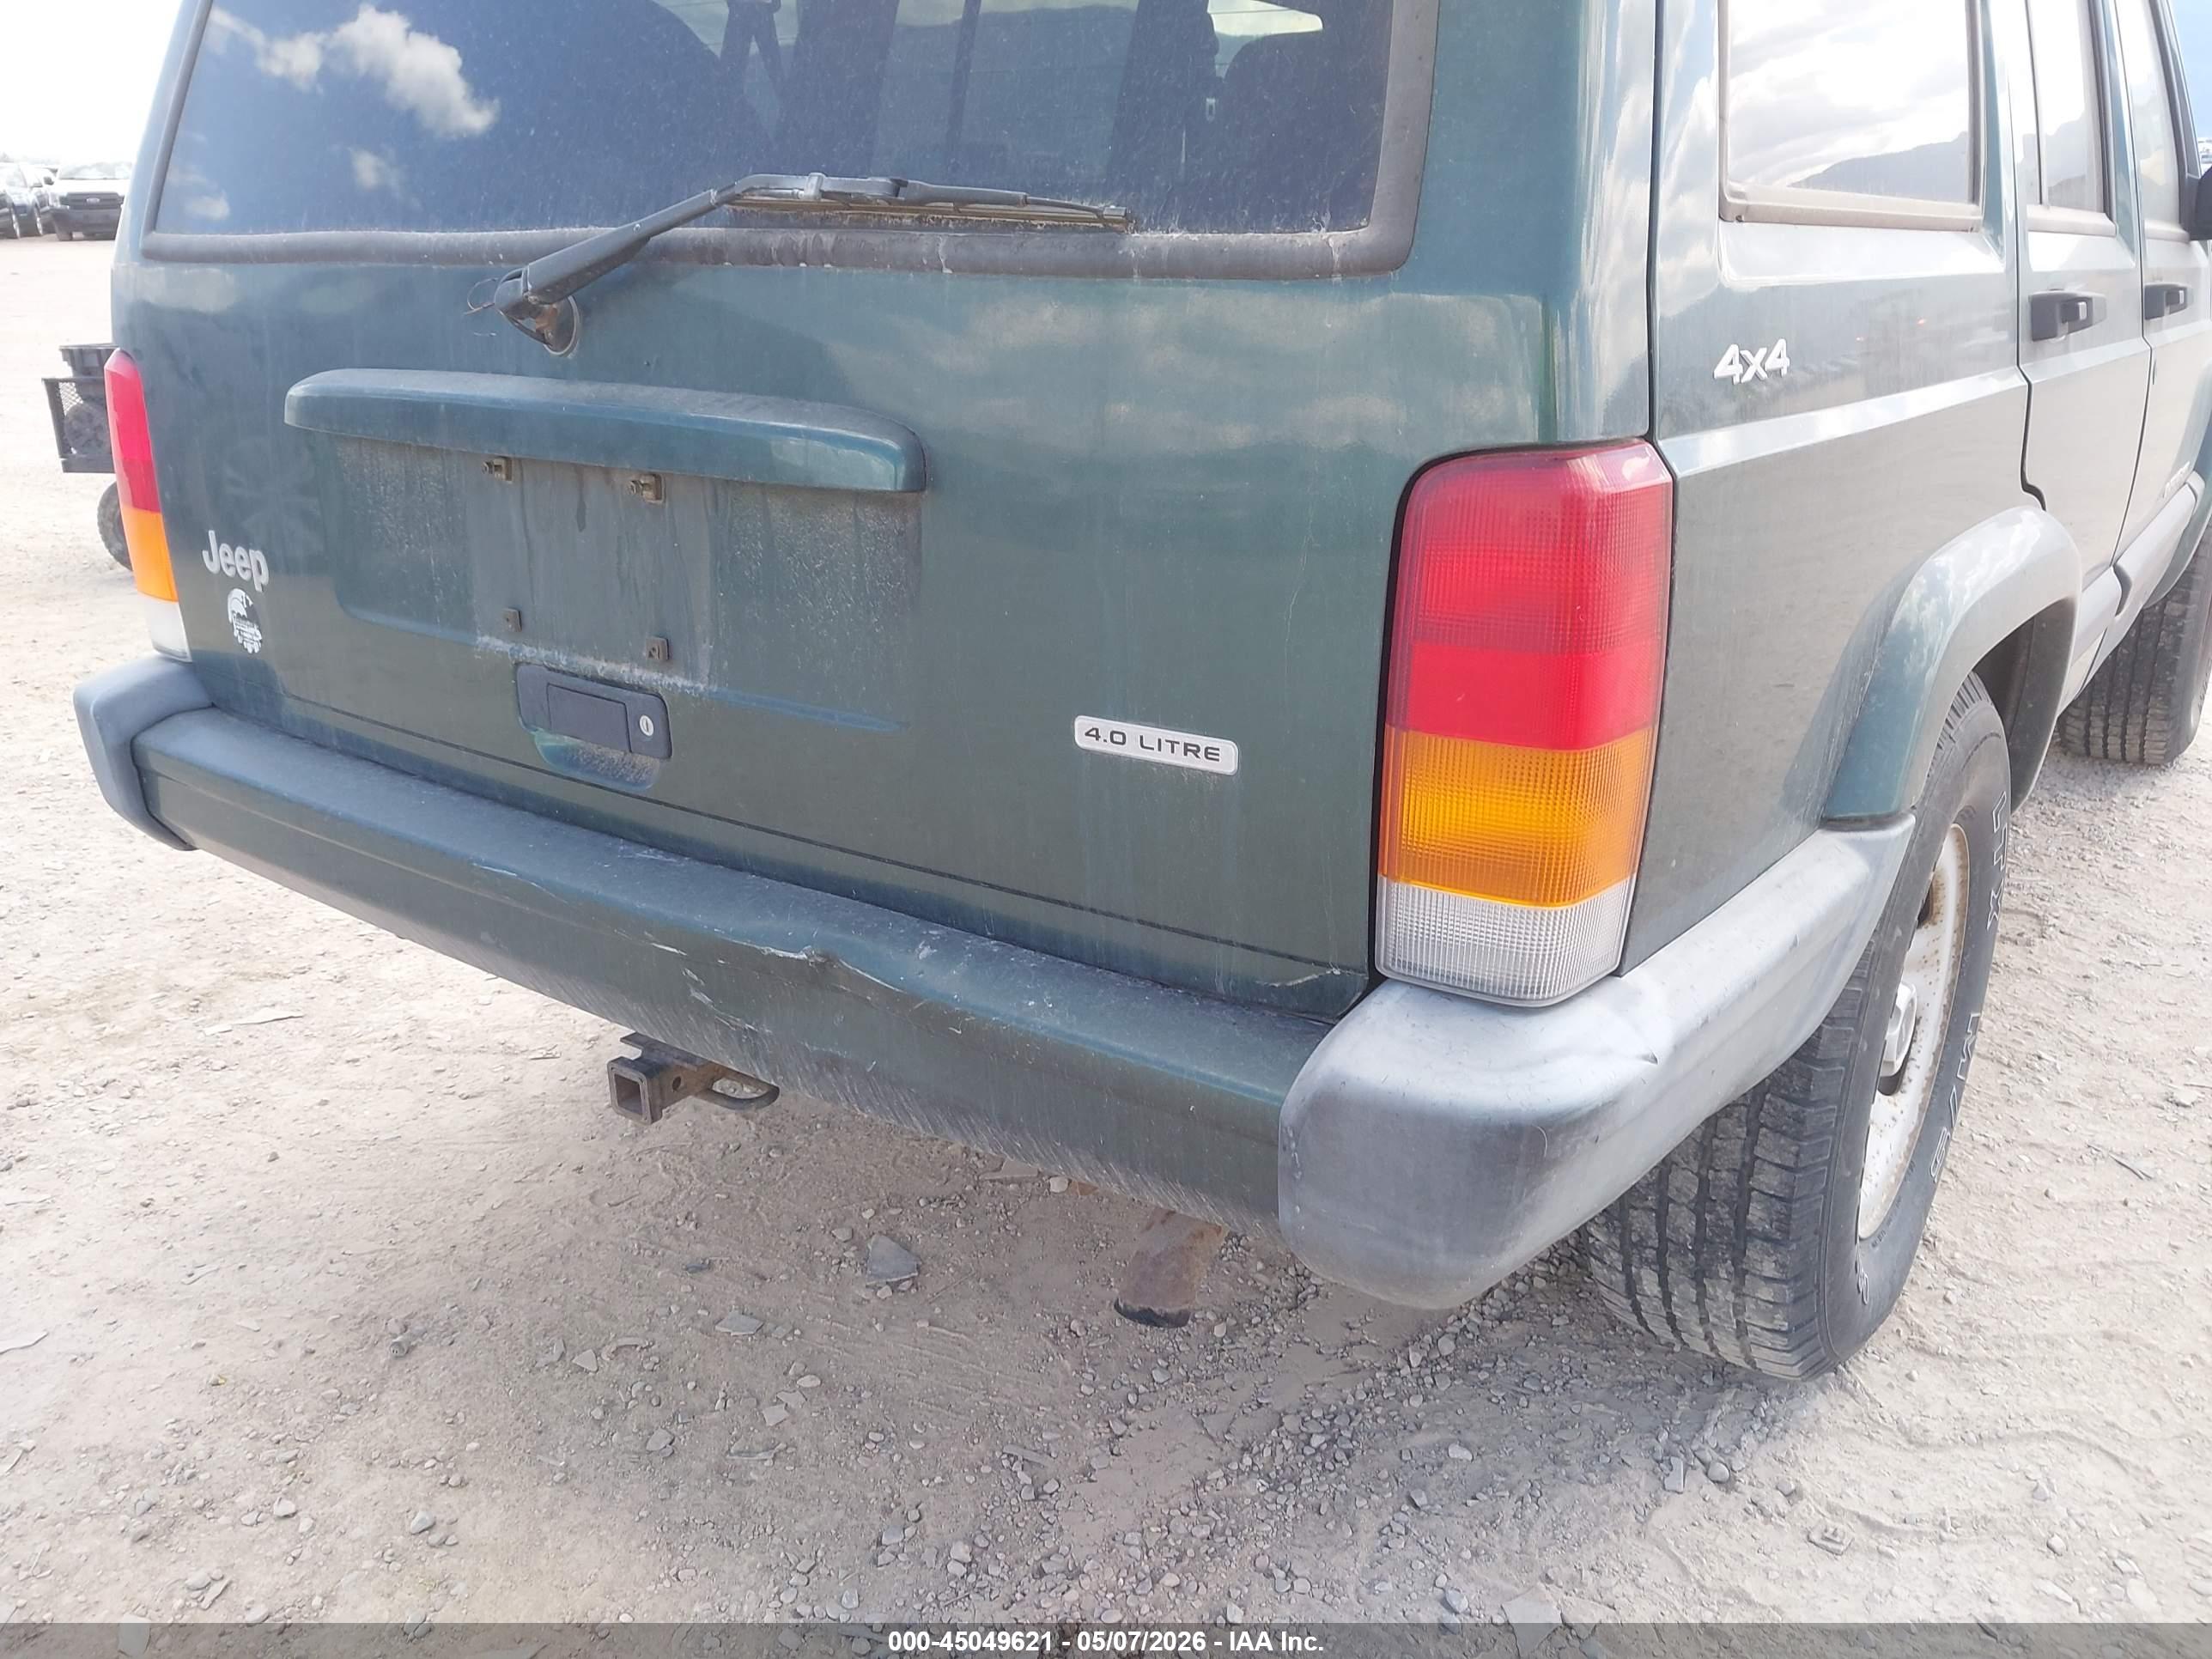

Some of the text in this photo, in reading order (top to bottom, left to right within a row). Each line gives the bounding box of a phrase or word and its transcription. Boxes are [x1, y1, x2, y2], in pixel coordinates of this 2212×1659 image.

[202, 530, 269, 592] Jeep
[1084, 727, 1220, 762] 4.0 LITRE
